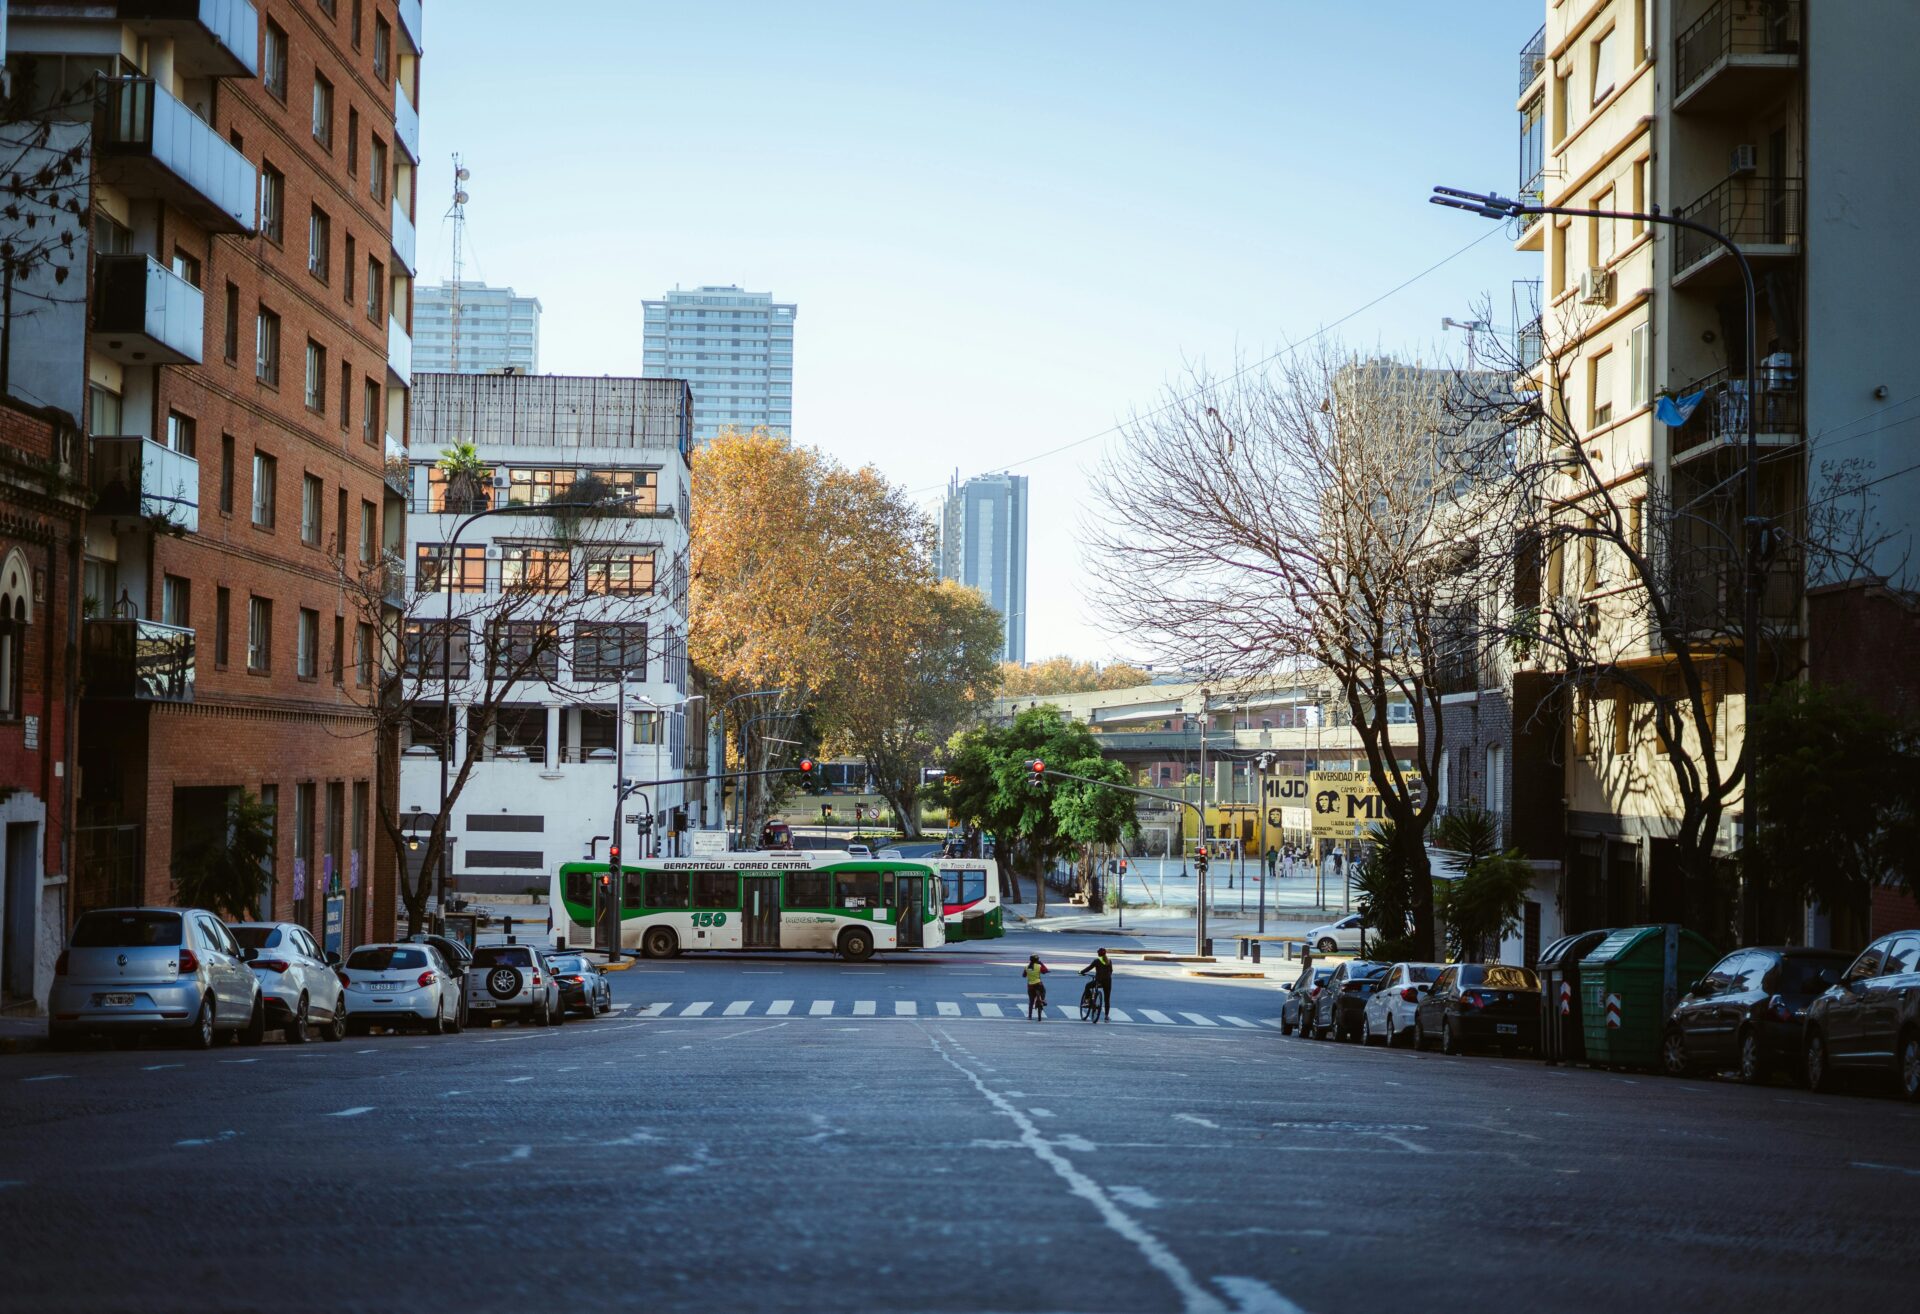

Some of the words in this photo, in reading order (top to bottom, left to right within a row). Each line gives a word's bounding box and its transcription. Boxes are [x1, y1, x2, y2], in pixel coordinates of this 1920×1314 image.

[1313, 772, 1353, 782] UNIVERSIDAD
[1262, 779, 1309, 798] MIJD
[664, 862, 725, 870] BERAZATEGUI
[733, 862, 769, 870] CORREO
[771, 862, 812, 870] CENTRAL
[690, 912, 727, 927] 159
